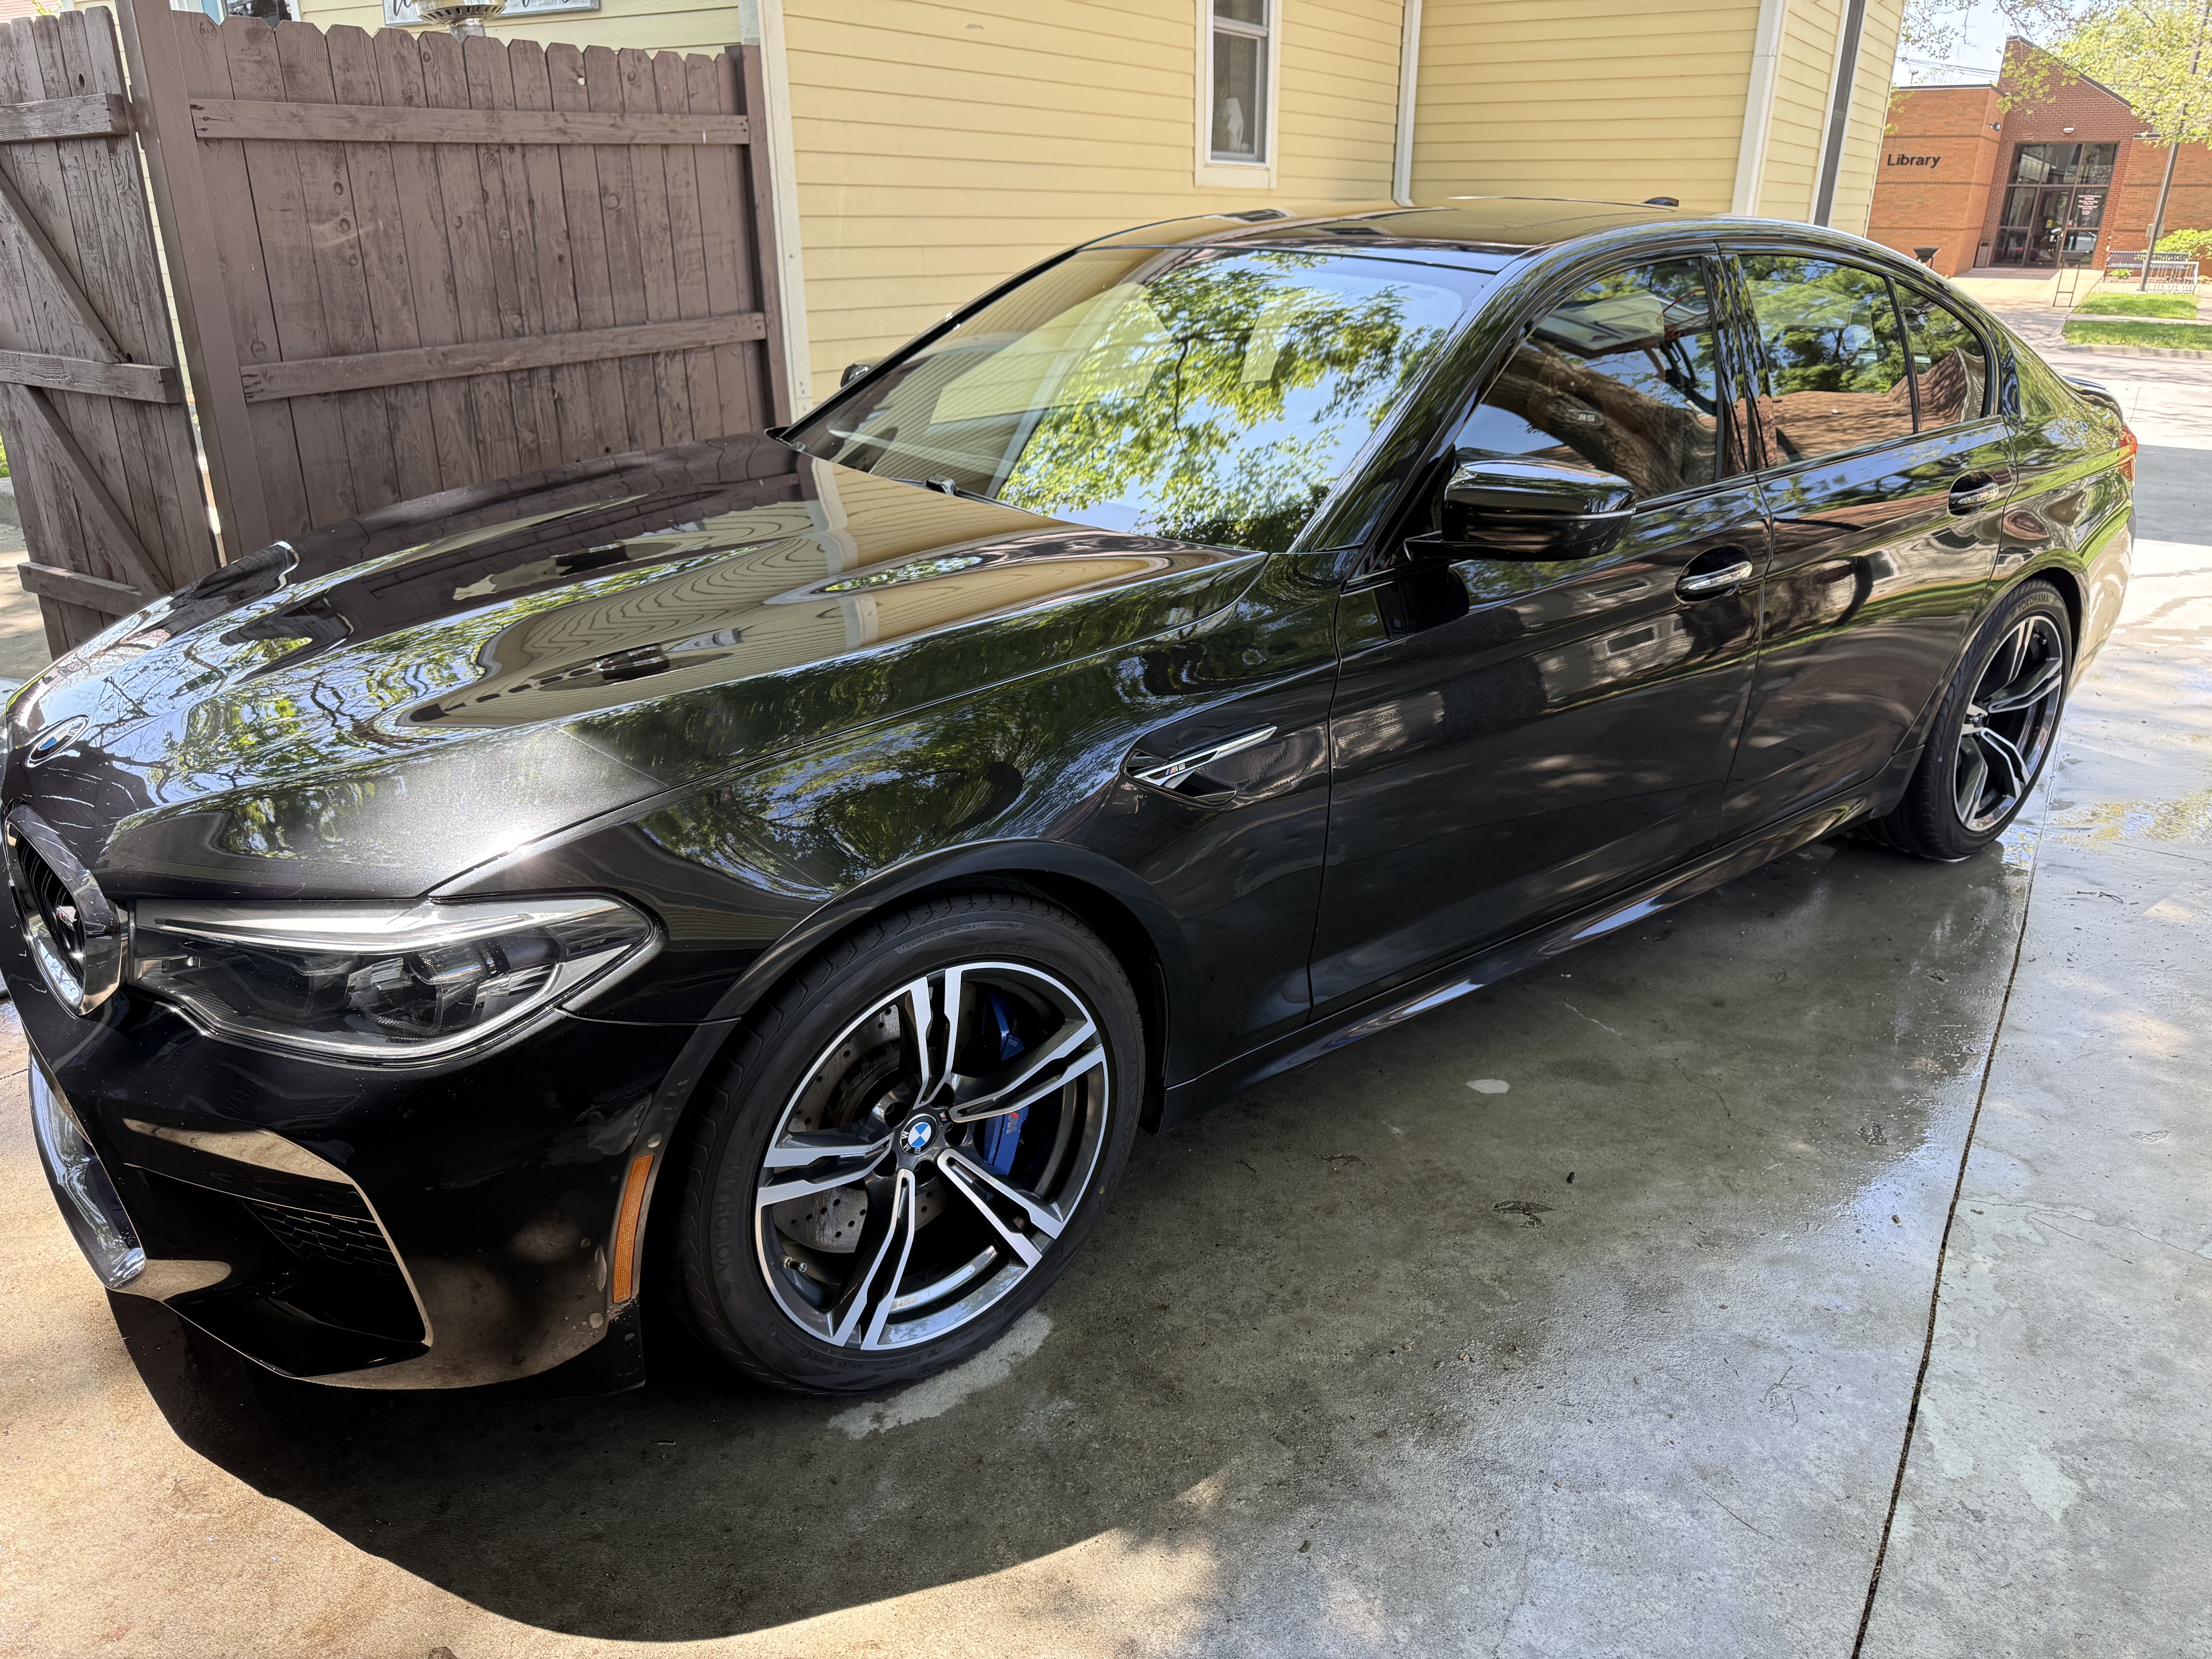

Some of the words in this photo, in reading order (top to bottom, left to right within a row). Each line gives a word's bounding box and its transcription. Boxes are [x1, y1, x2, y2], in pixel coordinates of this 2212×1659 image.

[1887, 154, 1941, 168] Library
[2017, 593, 2049, 612] YOKOHAMA
[902, 934, 934, 951] TREADWEAR
[947, 924, 972, 934] TRACTION
[901, 1130, 921, 1154] BMW
